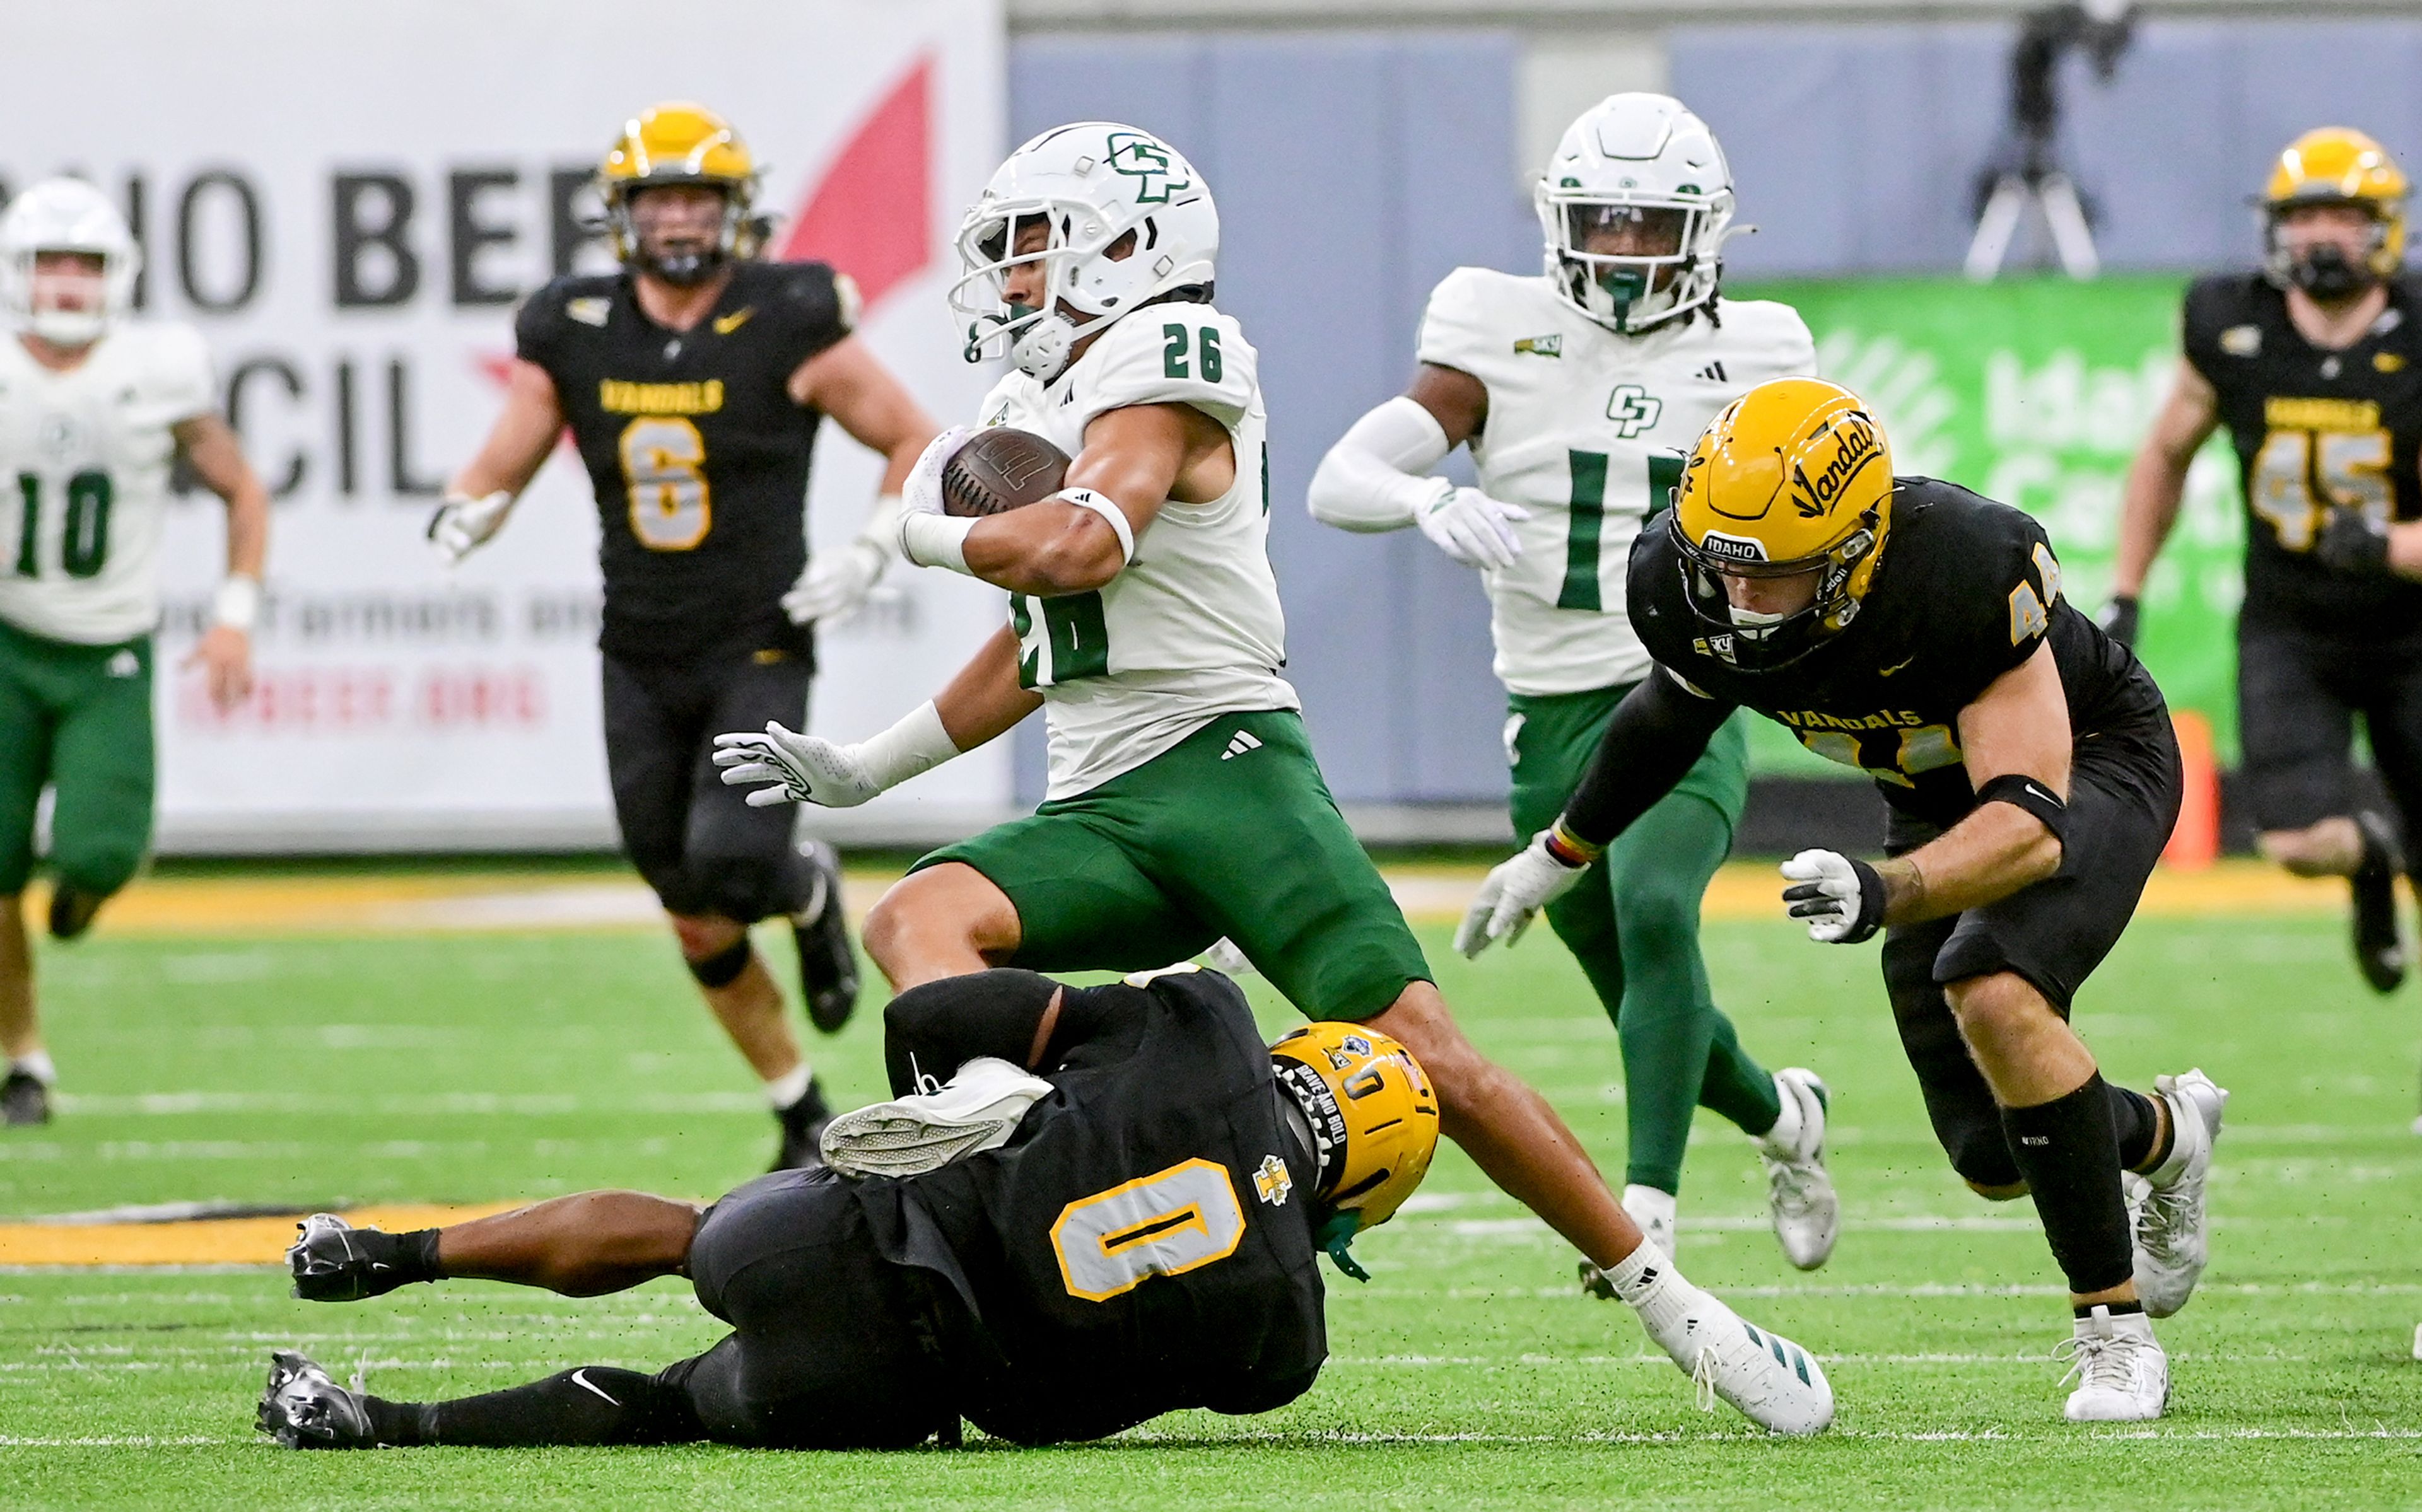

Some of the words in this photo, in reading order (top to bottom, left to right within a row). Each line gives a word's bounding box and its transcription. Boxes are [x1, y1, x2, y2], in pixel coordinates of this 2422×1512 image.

[1162, 323, 1222, 383] 26
[1606, 385, 1662, 439] CP
[618, 415, 713, 552] 6
[14, 470, 116, 580] 10
[1707, 537, 1756, 559] IDAHO
[1776, 708, 1925, 731] VANDALS
[1294, 1064, 1327, 1095] BRAVE
[1341, 1069, 1384, 1100] 0
[1316, 1090, 1337, 1116] AND
[1326, 1114, 1347, 1145] BOLD
[1049, 1156, 1246, 1303] 0
